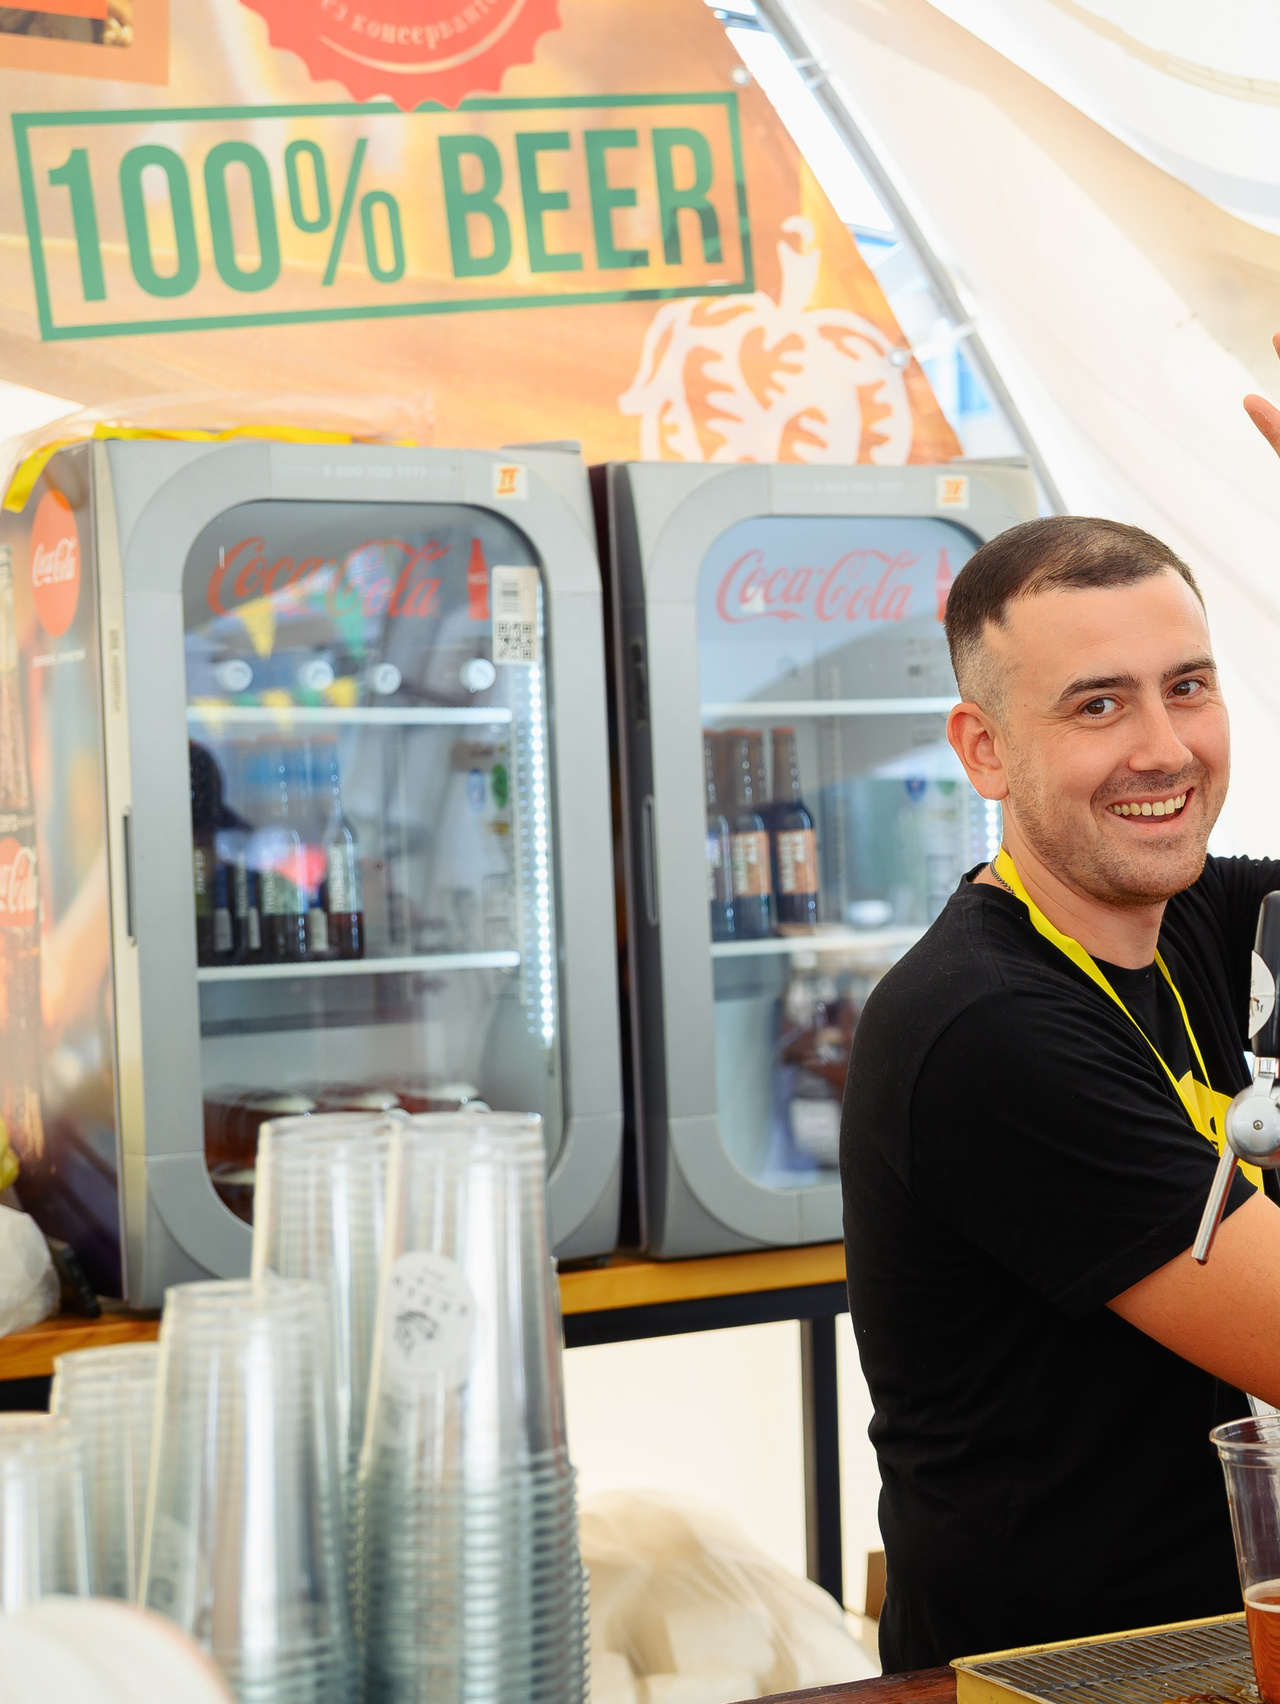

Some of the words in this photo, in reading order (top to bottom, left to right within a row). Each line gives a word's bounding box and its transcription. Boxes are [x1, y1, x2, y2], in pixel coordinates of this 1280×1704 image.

[351, 0, 498, 51] консервант
[48, 138, 406, 301] 100%
[437, 127, 724, 279] BEER
[716, 549, 922, 623] Coca-Cola
